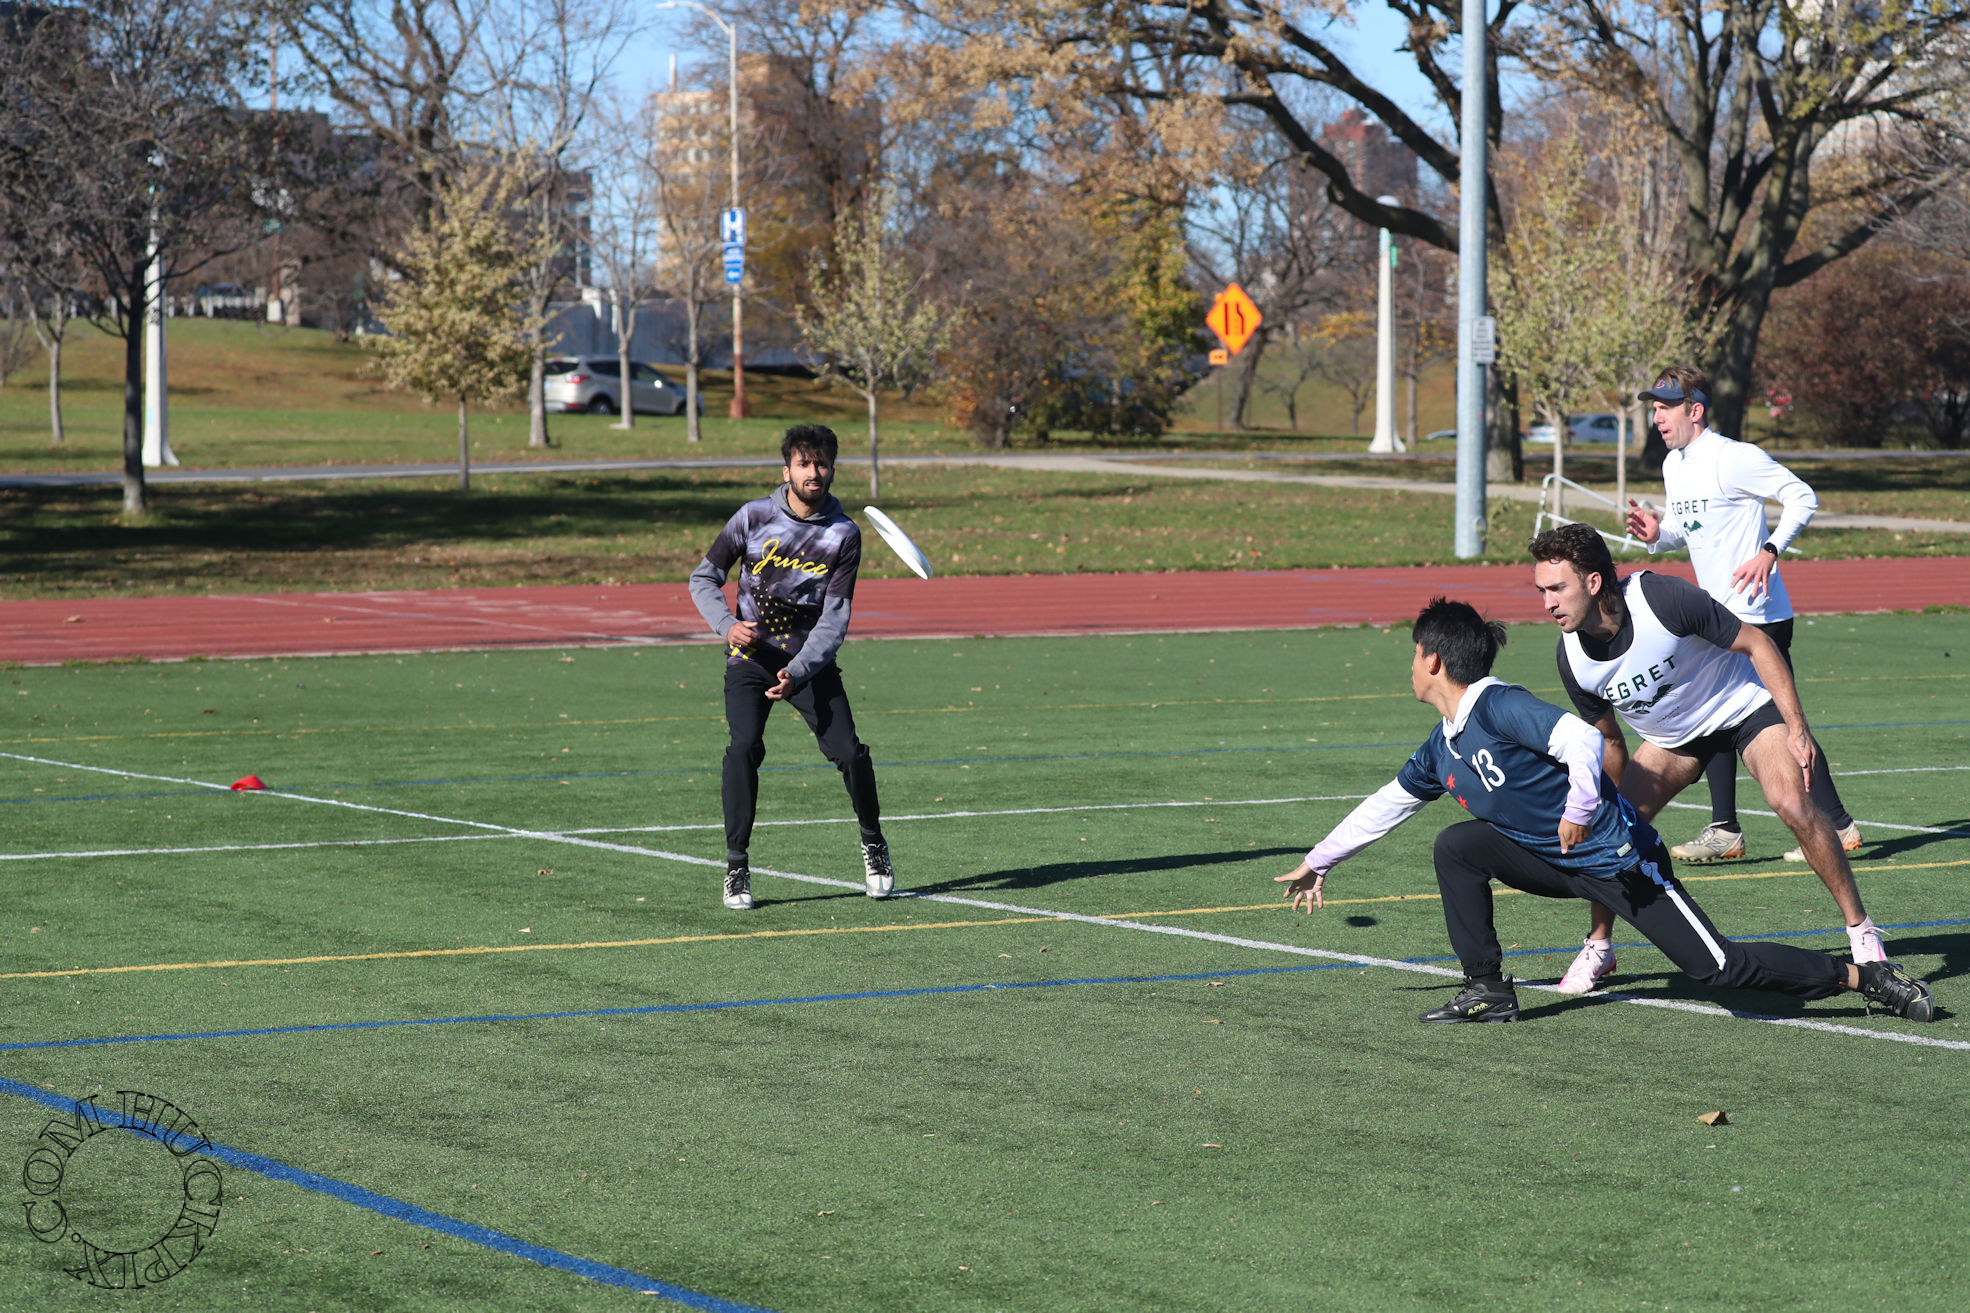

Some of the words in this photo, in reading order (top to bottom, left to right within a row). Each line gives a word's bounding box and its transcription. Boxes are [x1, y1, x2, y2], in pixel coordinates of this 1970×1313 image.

[722, 211, 744, 242] H
[752, 538, 829, 575] Juice
[1605, 655, 1676, 701] EGRET
[1471, 748, 1506, 793] 13
[1467, 1002, 1489, 1016] ALPHA
